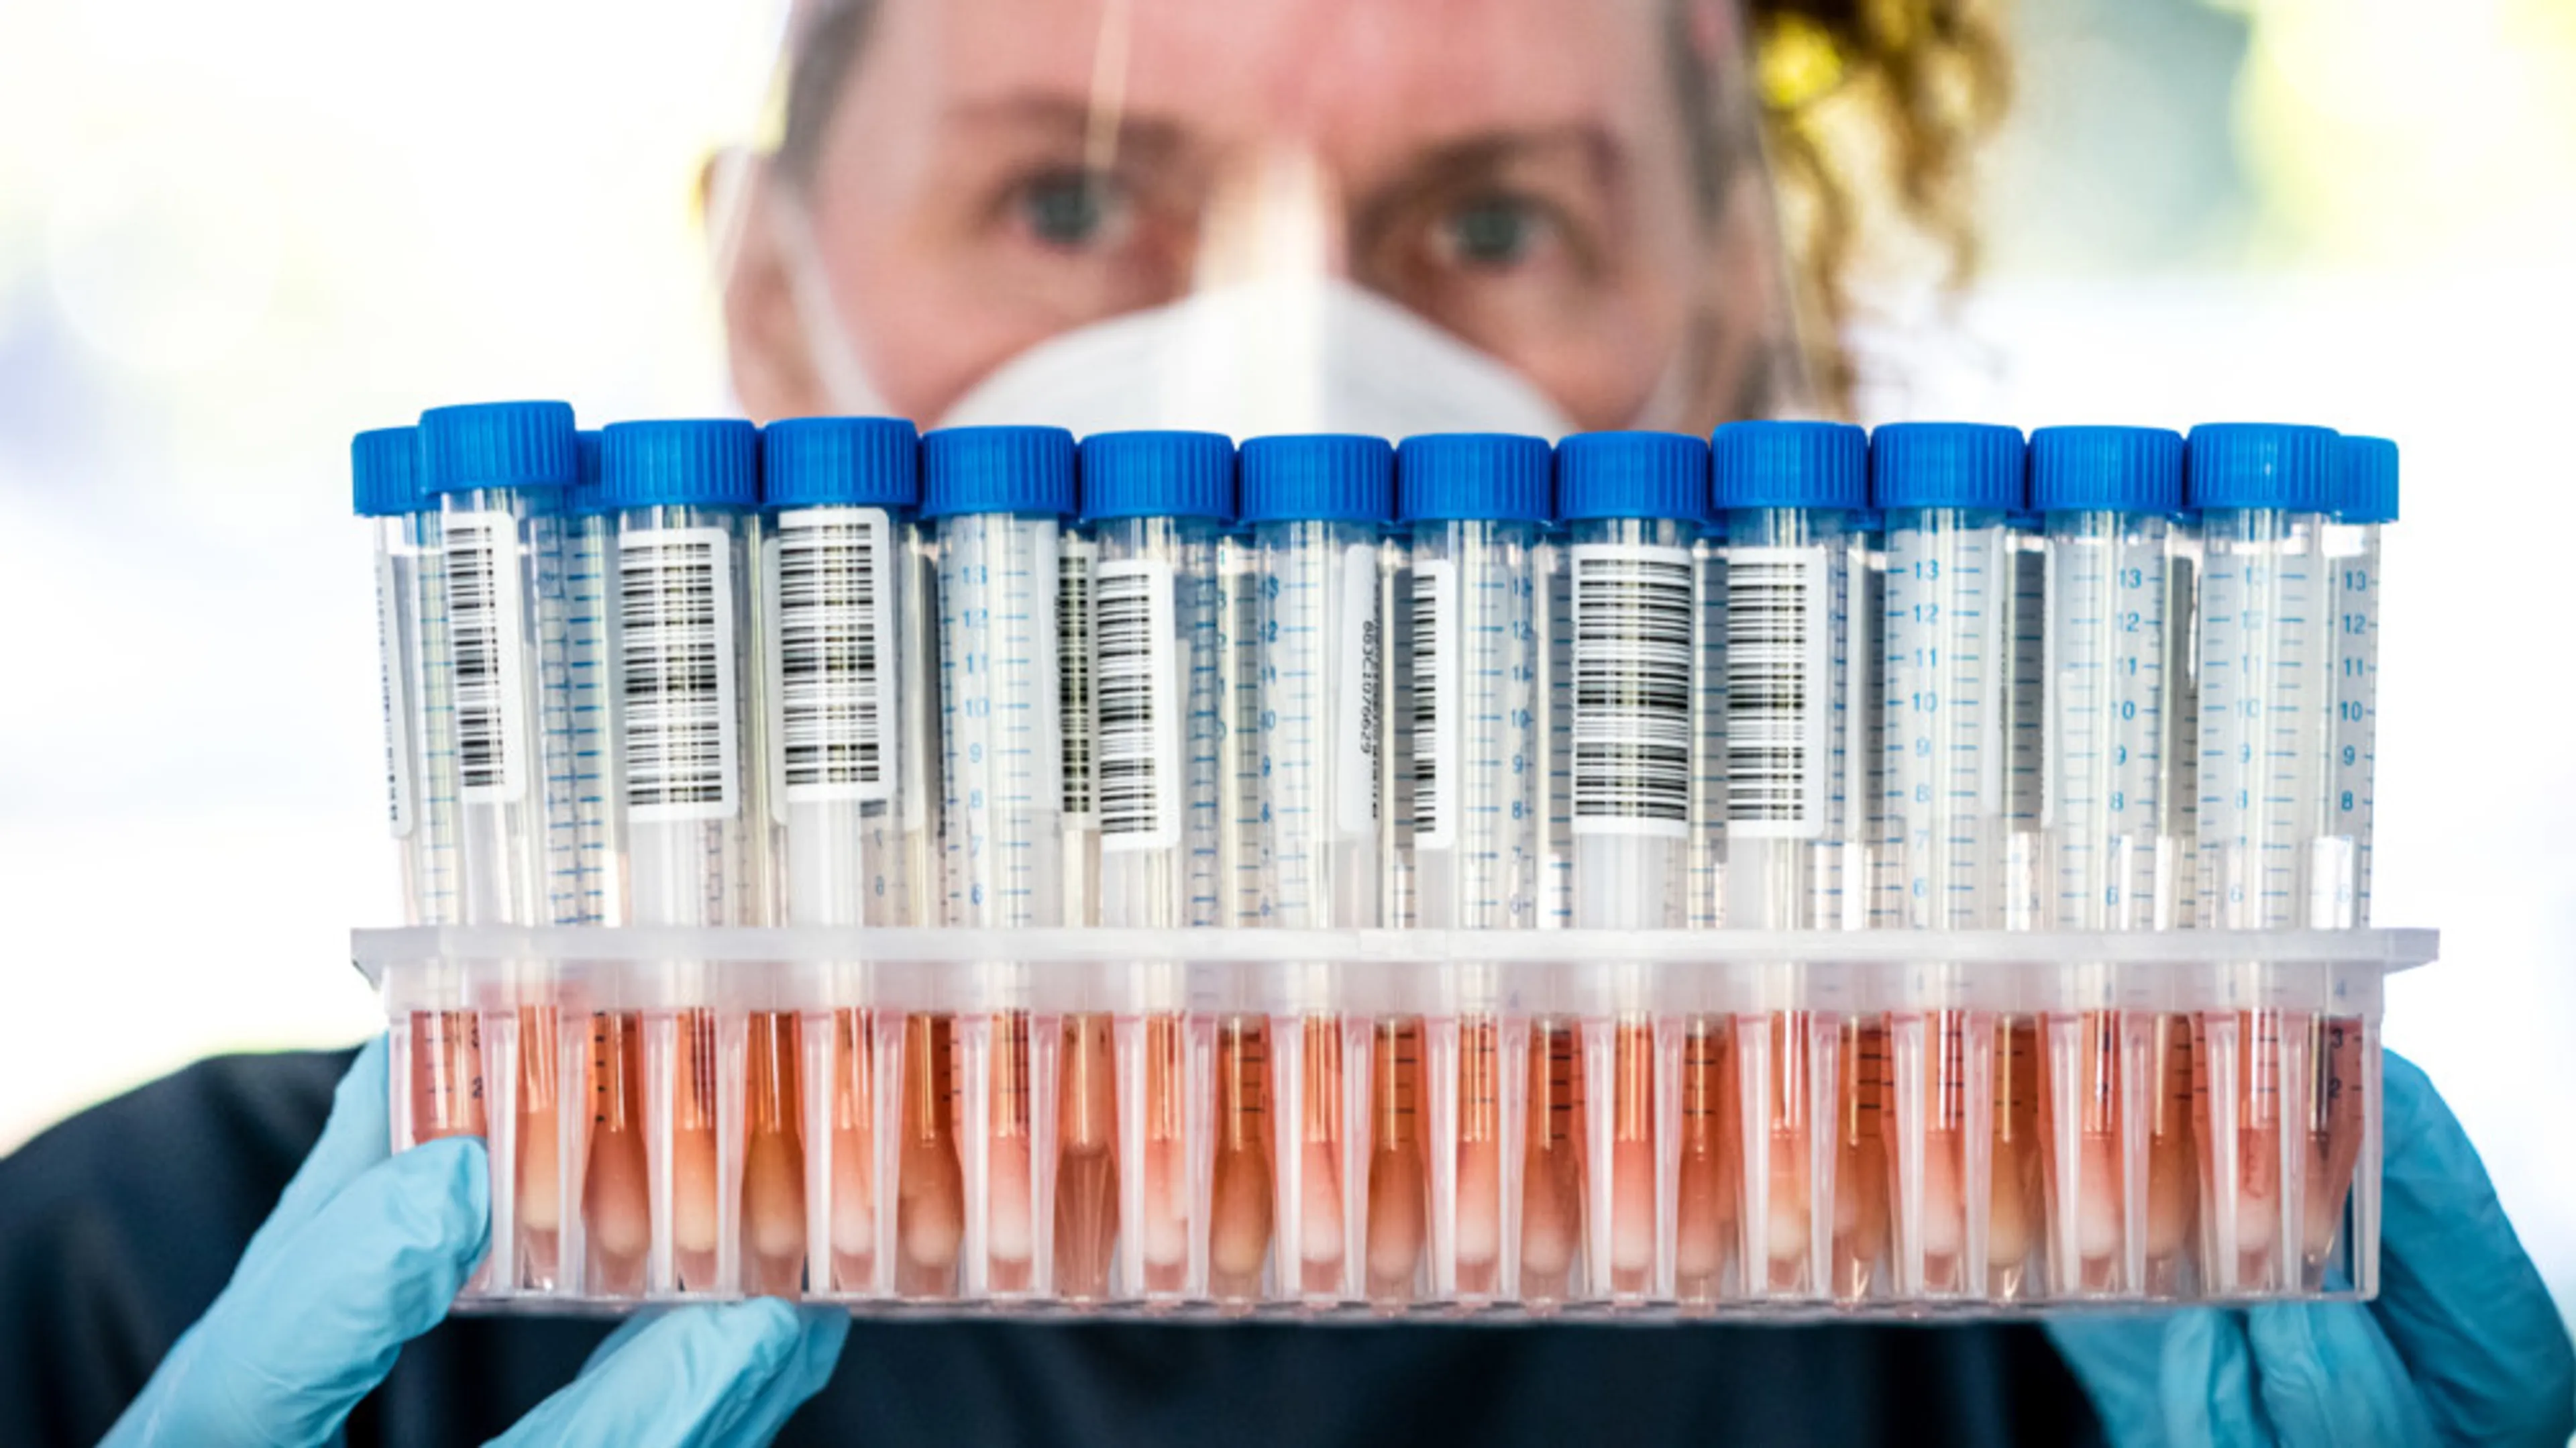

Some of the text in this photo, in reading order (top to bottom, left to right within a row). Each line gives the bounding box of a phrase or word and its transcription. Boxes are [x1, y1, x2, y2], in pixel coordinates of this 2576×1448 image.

[1916, 559, 1939, 580] 13
[2119, 567, 2142, 588] 13
[2245, 566, 2268, 586] 1
[2345, 569, 2367, 591] 13
[1913, 603, 1939, 625] 12
[2117, 611, 2141, 633] 12
[2343, 614, 2366, 635] 12
[1915, 647, 1937, 668] 11
[2117, 656, 2137, 677] 11
[2343, 657, 2364, 678] 11
[1912, 692, 1938, 713] 10
[2110, 700, 2136, 721] 10
[2341, 700, 2363, 722] 10
[1512, 754, 1523, 774] 9
[2343, 744, 2356, 766] 9
[2110, 791, 2125, 812] 8
[2341, 790, 2353, 811] 8
[2106, 885, 2119, 907] 6
[2330, 1027, 2344, 1048] 3
[2327, 1076, 2342, 1098] 2
